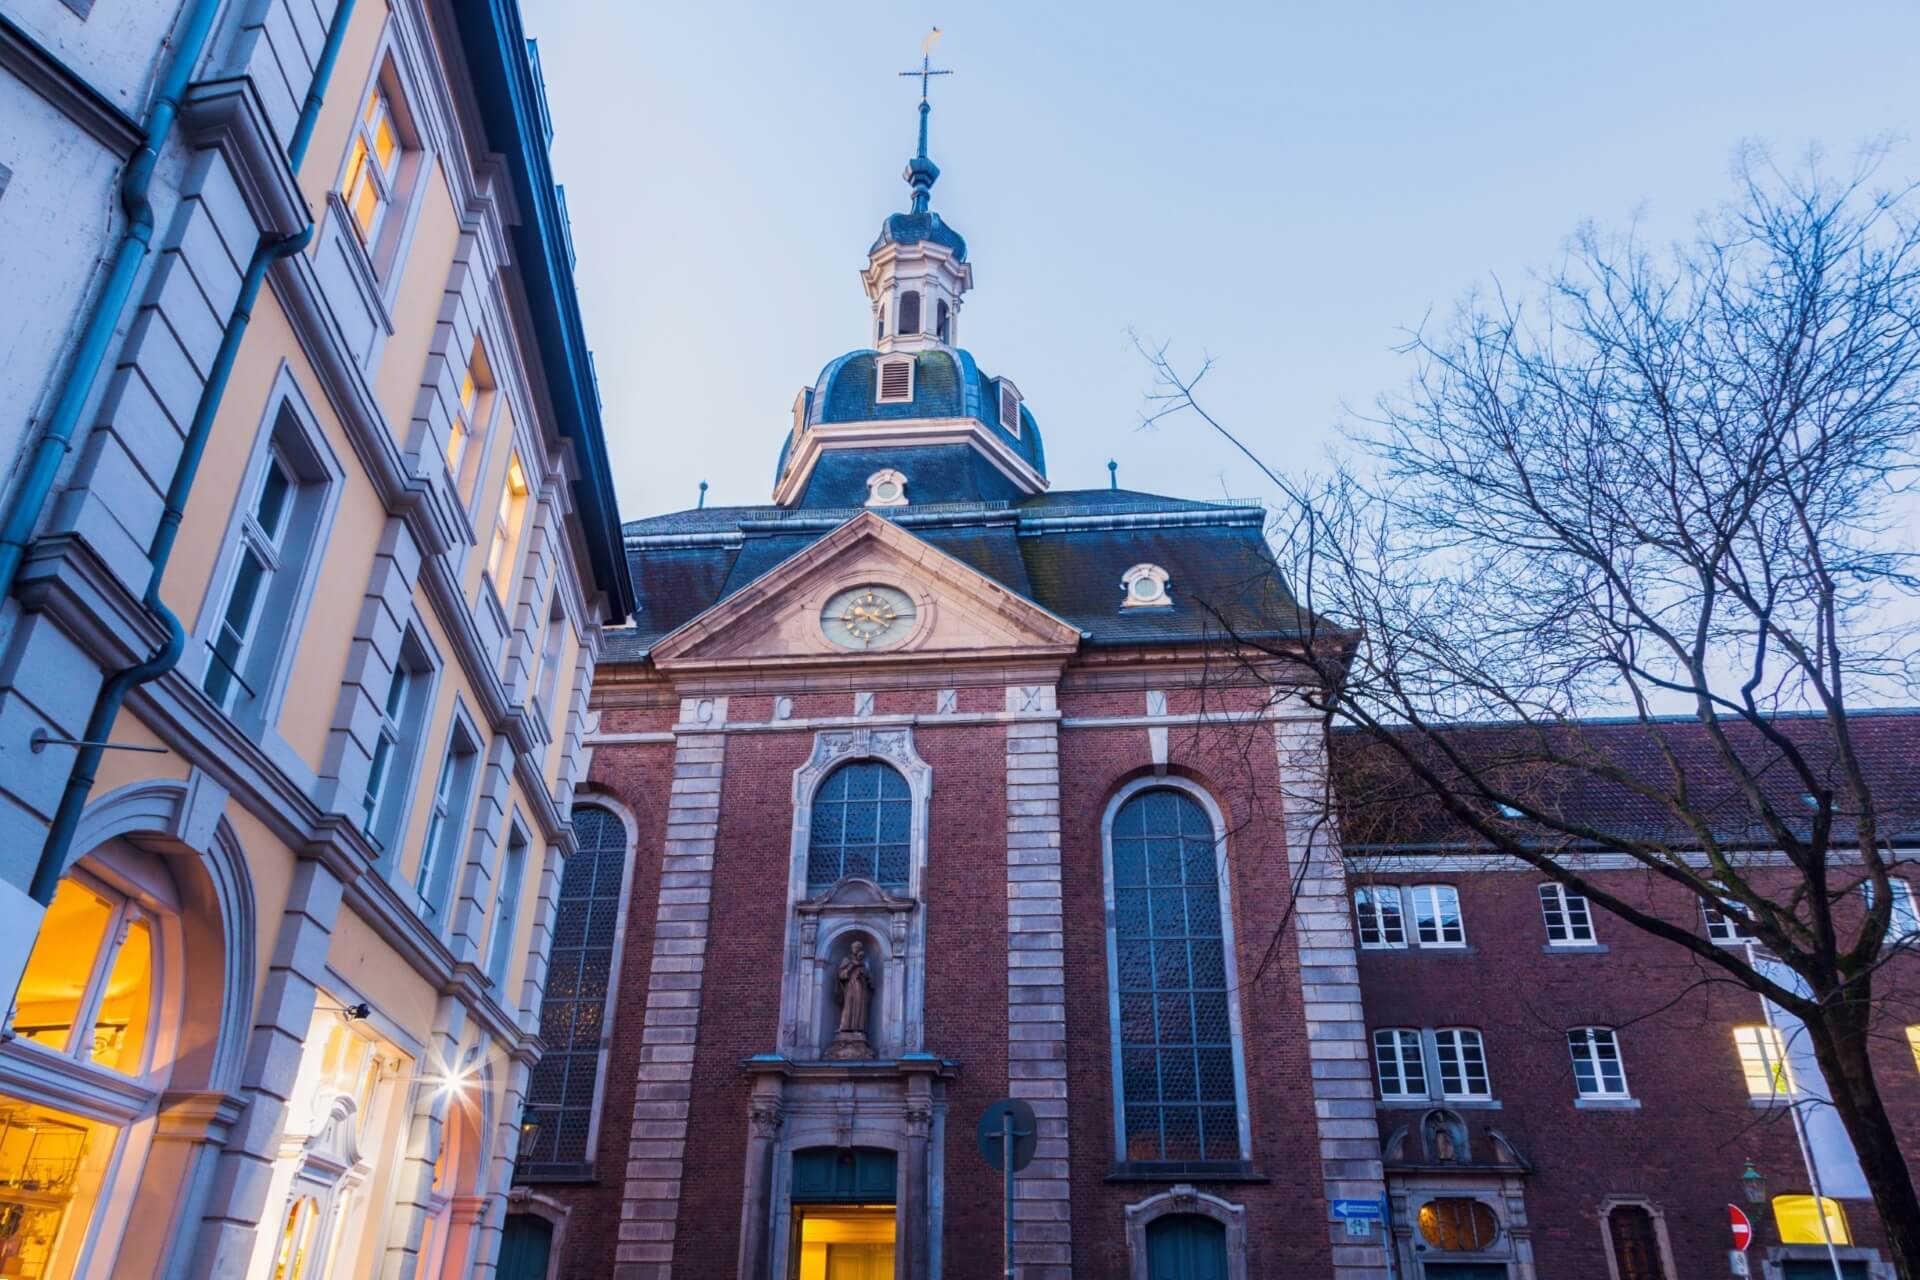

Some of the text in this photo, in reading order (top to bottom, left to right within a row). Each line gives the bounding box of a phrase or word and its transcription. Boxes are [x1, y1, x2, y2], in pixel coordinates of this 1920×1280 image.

[696, 698, 715, 723] C
[777, 696, 793, 720] C
[857, 692, 875, 716] X
[938, 690, 957, 714] X
[1019, 687, 1042, 712] X
[1150, 690, 1166, 714] V
